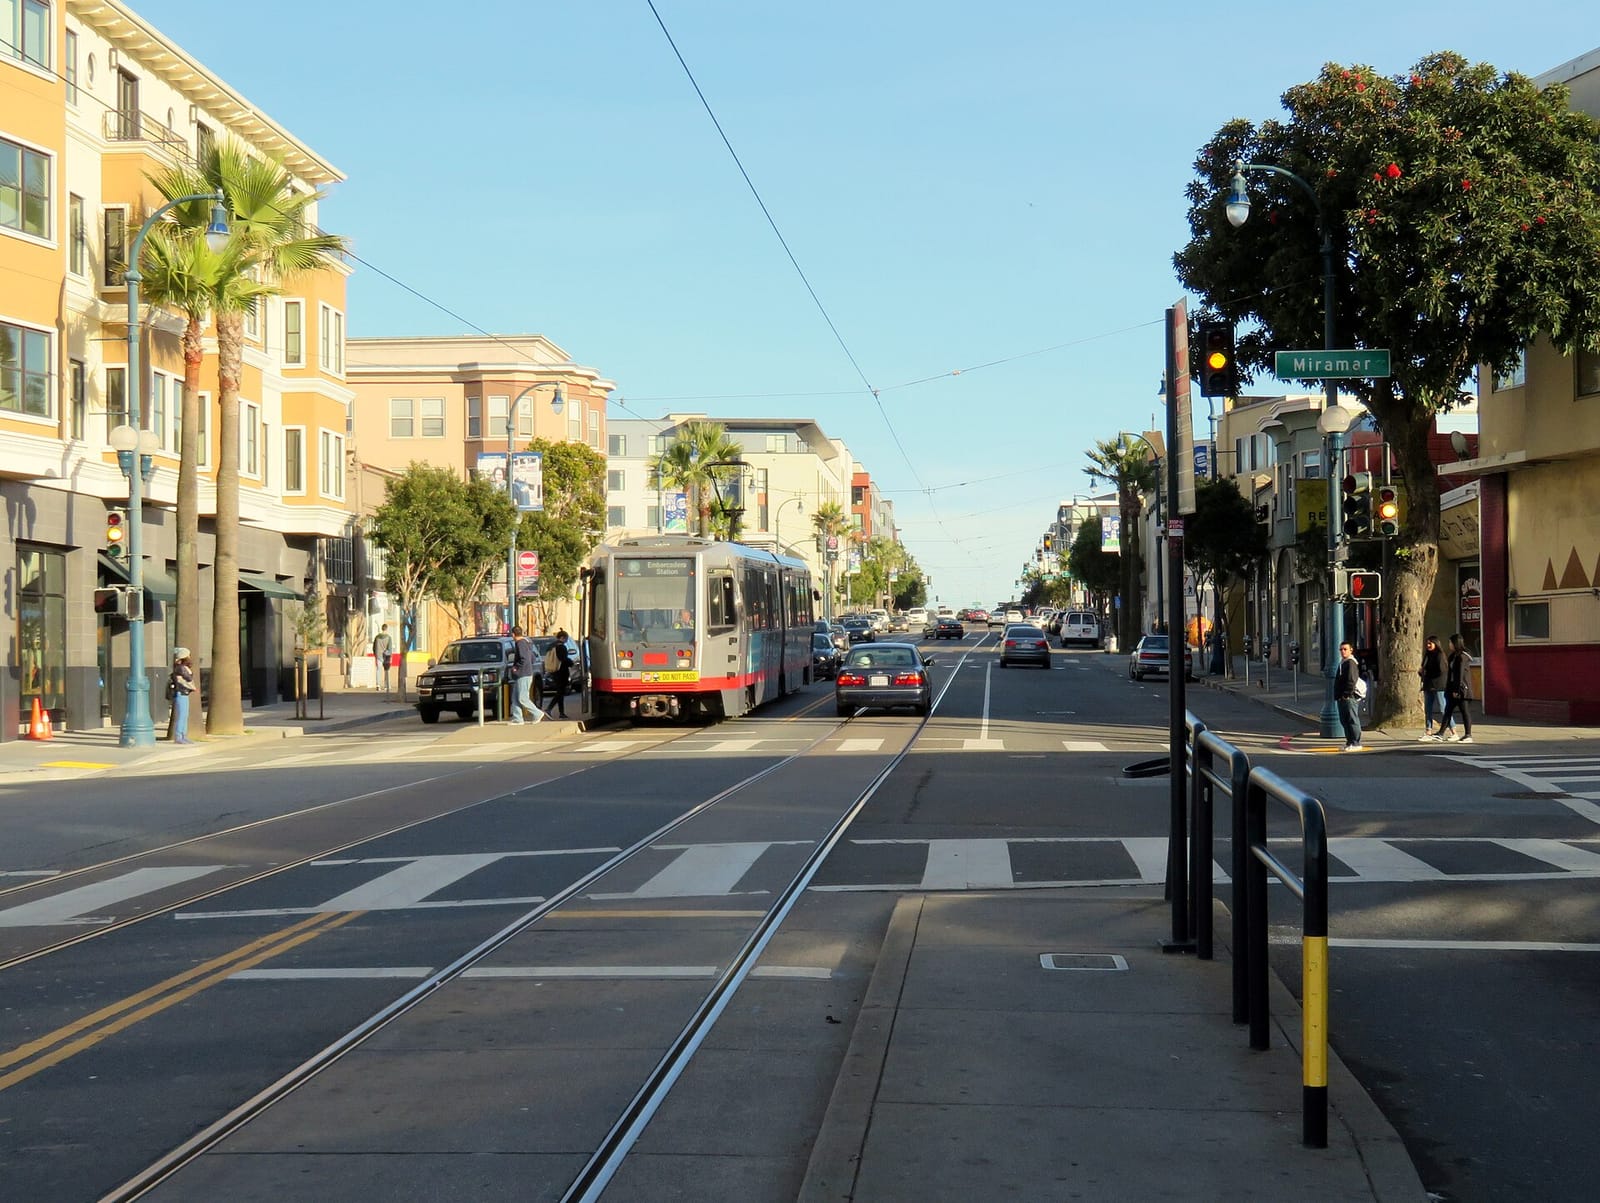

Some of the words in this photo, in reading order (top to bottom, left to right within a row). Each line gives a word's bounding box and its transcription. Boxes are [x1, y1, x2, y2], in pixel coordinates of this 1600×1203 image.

[1293, 358, 1371, 372] Miramar
[656, 568, 679, 576] Station
[662, 673, 670, 681] DO
[671, 673, 682, 681] NOT
